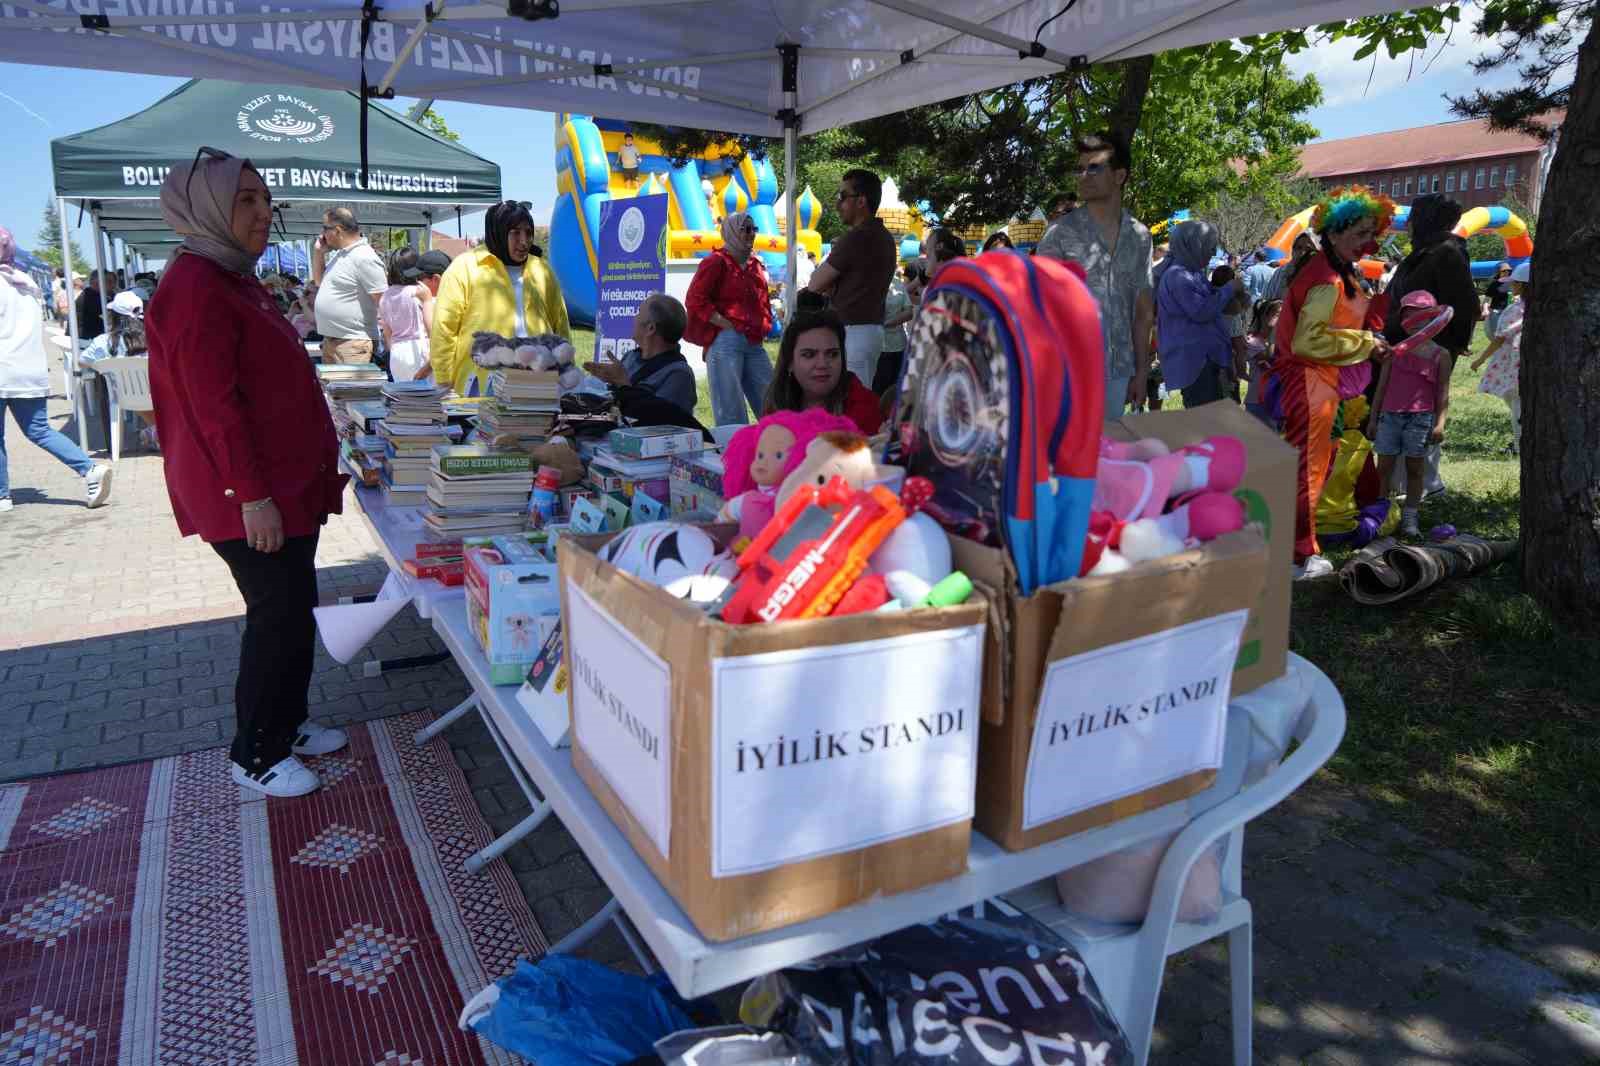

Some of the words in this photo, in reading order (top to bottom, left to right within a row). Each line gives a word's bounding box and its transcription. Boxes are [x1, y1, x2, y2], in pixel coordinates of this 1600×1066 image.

[291, 168, 351, 189] BAYSAL
[355, 169, 458, 193] ÜNİVERSİTESİ
[608, 691, 659, 761] STANDI
[736, 730, 851, 773] İYİLİK
[858, 708, 967, 753] STANDI
[1049, 704, 1131, 747] İYİLİK
[1137, 677, 1219, 721] STANDI
